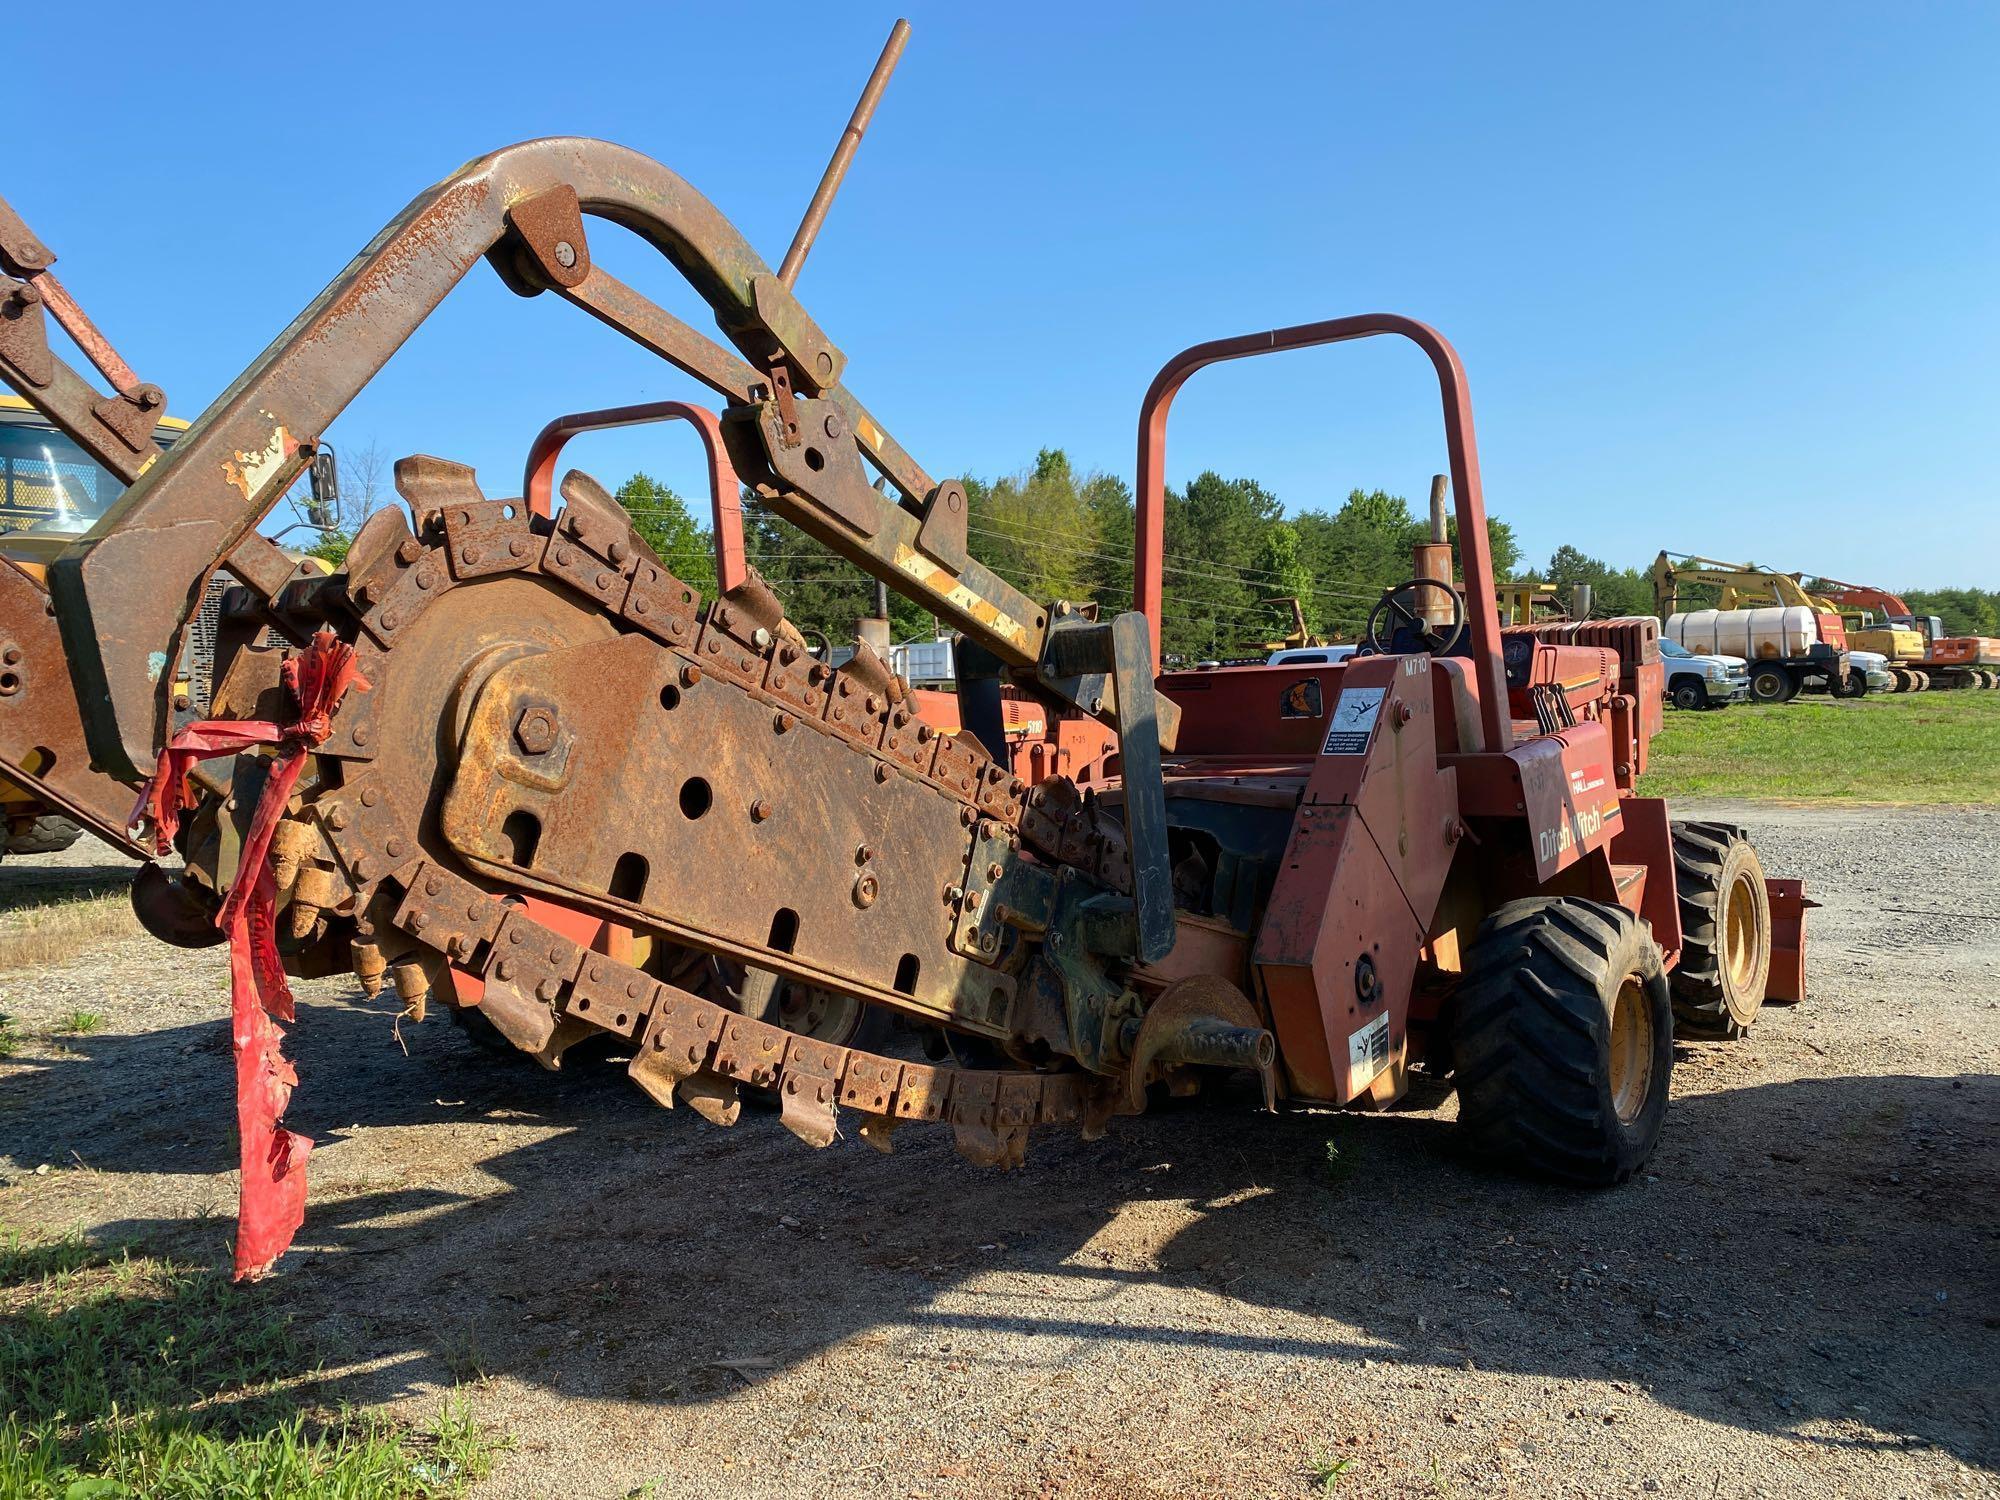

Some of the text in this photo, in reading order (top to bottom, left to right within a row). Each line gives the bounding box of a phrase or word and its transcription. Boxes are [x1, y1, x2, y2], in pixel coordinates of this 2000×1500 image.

[1696, 575, 1727, 584] KOMATSU
[1405, 657, 1427, 676] M710
[1572, 778, 1586, 795] HALL
[1540, 804, 1601, 864] Ditch Witch
